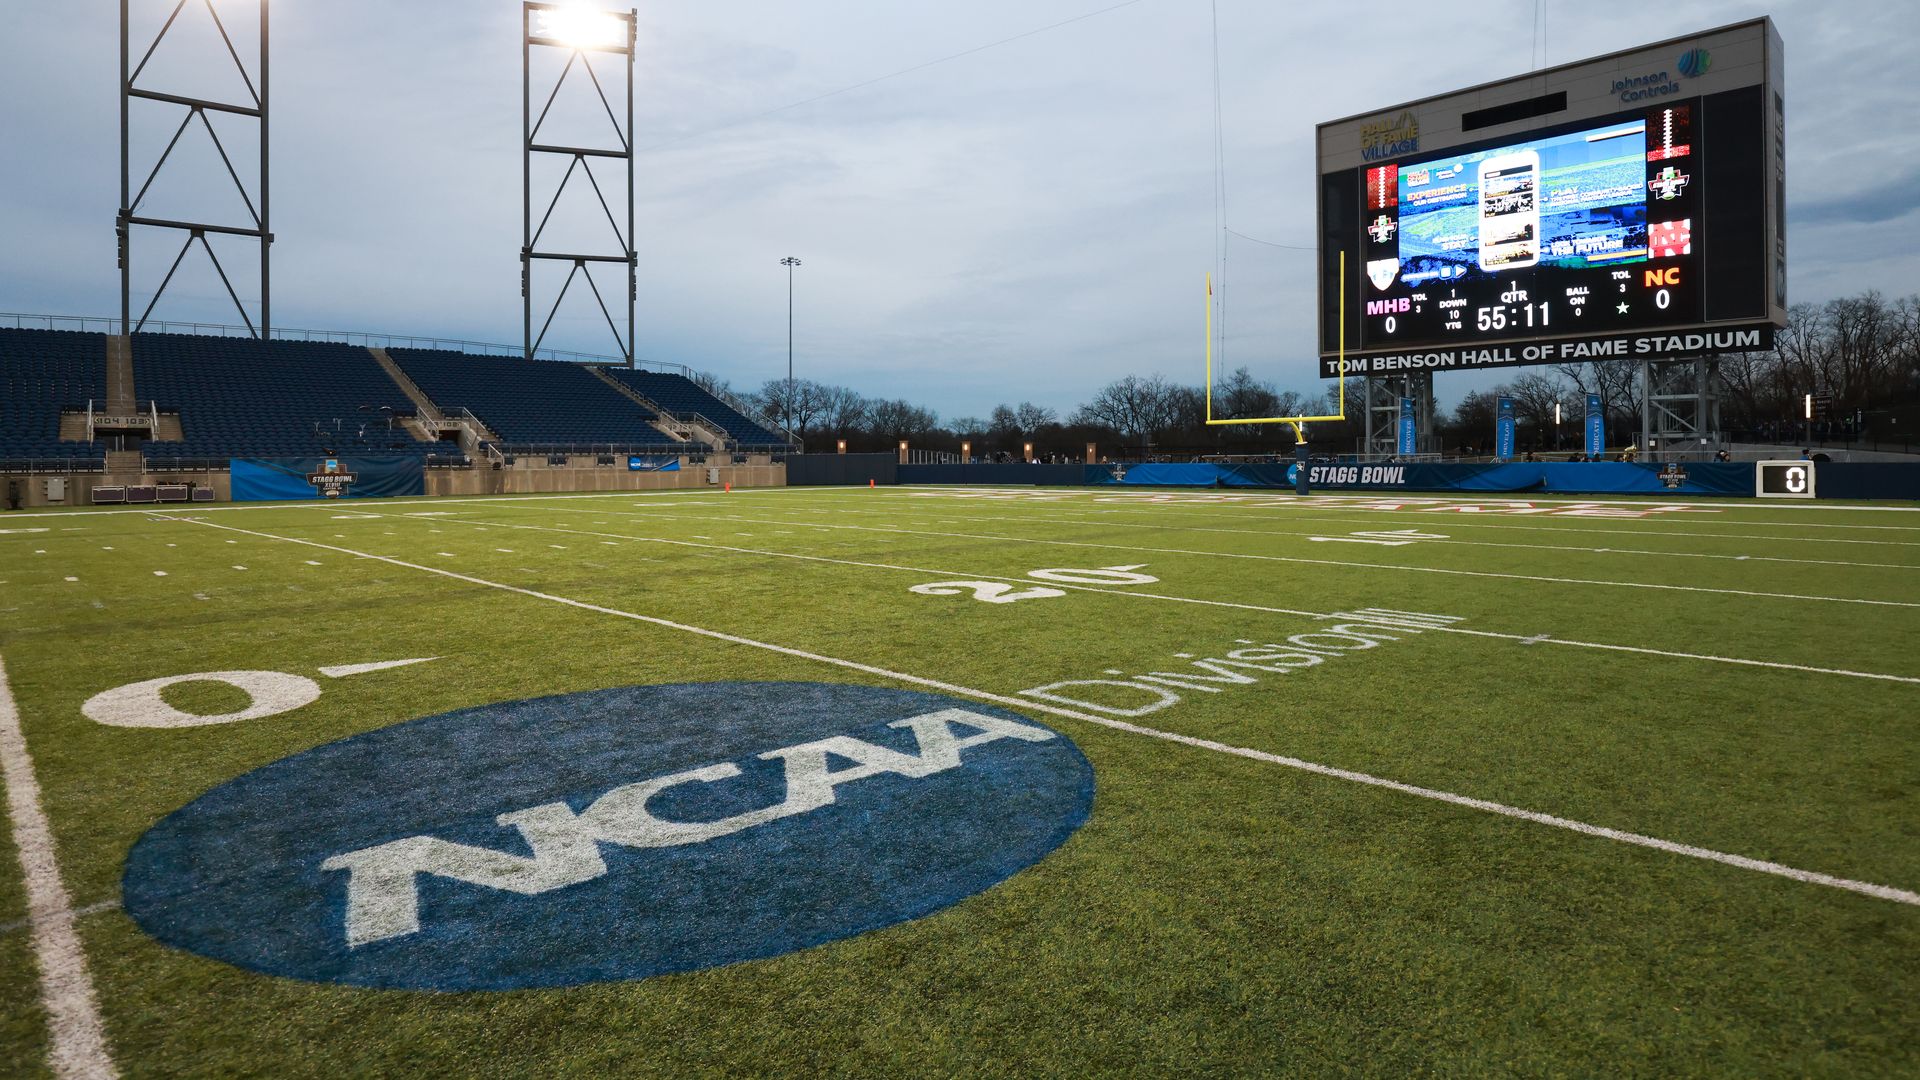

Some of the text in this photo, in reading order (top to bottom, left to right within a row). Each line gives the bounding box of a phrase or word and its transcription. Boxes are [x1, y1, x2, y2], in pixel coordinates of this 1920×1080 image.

[1610, 72, 1667, 95] Johnson
[1621, 81, 1680, 102] Controls
[1361, 118, 1392, 137] HALL
[1361, 134, 1378, 149] OF
[1384, 127, 1418, 145] FAME
[1361, 138, 1418, 160] VILLAGE
[1407, 184, 1467, 201] EXPERIENCE
[1576, 240, 1624, 255] FUTURE
[1611, 270, 1631, 280] TOL
[1645, 267, 1680, 287] NC
[1450, 289, 1456, 298] 1
[1510, 280, 1517, 292] 1
[1566, 286, 1590, 296] BALL
[1619, 283, 1626, 293] 3
[1412, 293, 1427, 302] TOL
[1439, 299, 1467, 309] DOWN
[1501, 290, 1528, 304] QTR
[1569, 297, 1585, 305] ON
[1656, 289, 1670, 309] 0
[1367, 298, 1411, 315] MHB
[1415, 305, 1421, 313] 3
[1449, 310, 1460, 319] 10
[1575, 308, 1581, 316] 0
[1477, 301, 1549, 331] 55:11
[1385, 316, 1396, 334] 0
[1445, 322, 1462, 330] YTG
[1327, 330, 1760, 374] TOM BENSON HALL OF FAME STADIUM
[1309, 467, 1405, 483] STAGG BOWL
[1786, 467, 1805, 492] 0
[1307, 531, 1451, 546] 10
[908, 568, 1160, 604] 20
[1018, 623, 1422, 716] Division
[321, 707, 1057, 949] NCAA
